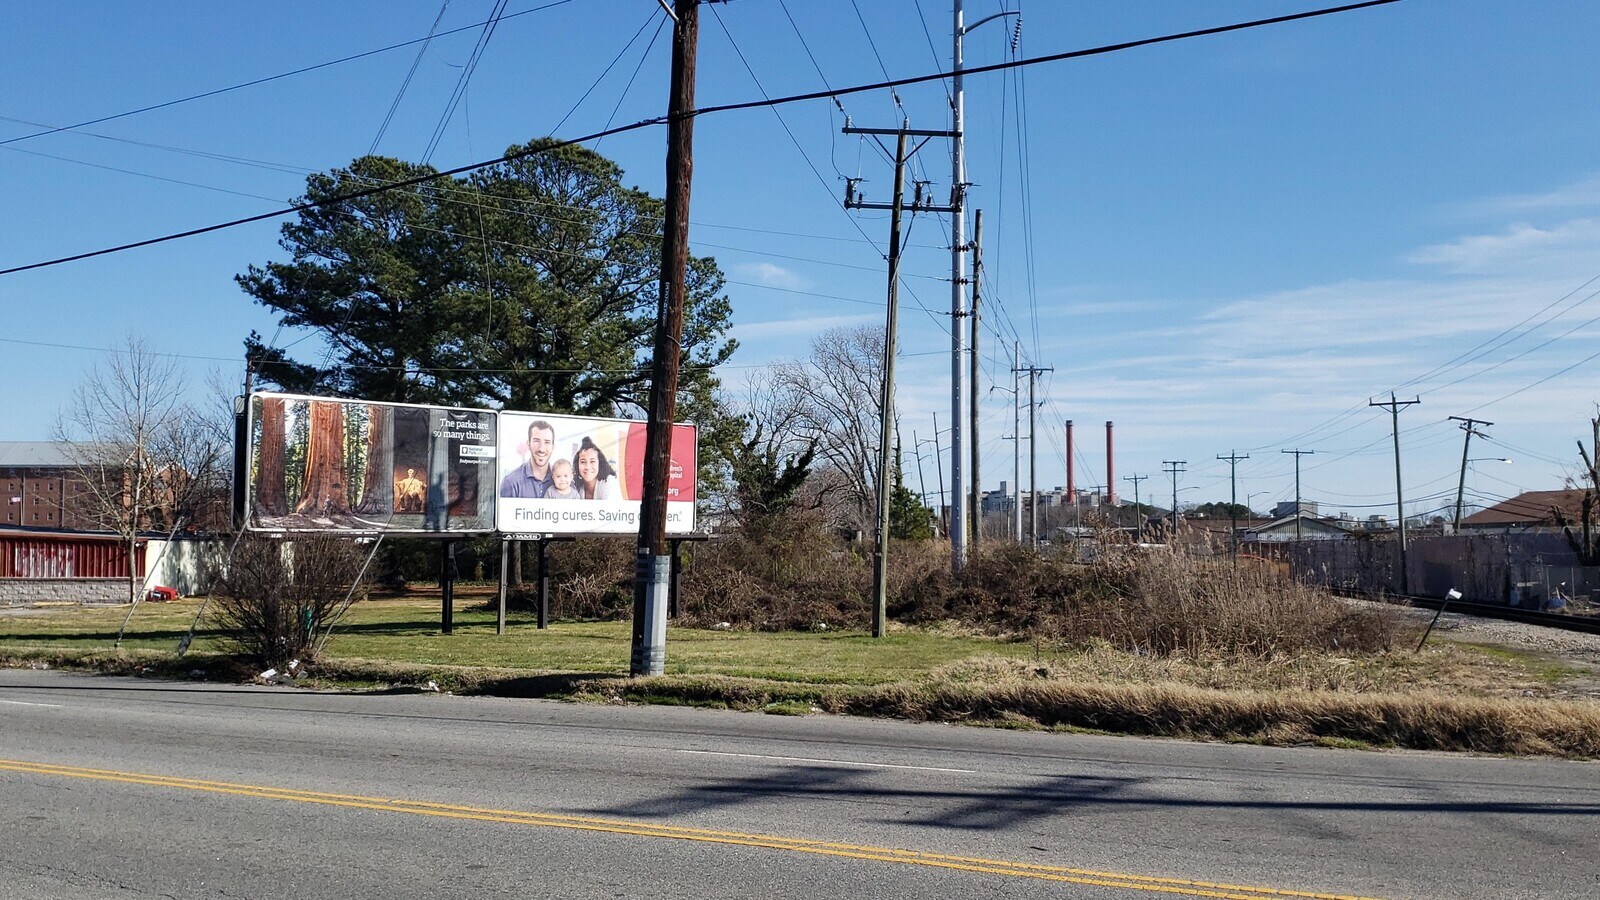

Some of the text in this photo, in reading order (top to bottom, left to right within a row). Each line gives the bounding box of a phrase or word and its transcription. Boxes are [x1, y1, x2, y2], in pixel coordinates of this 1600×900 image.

[440, 418, 455, 427] The
[456, 420, 476, 429] parks
[443, 431, 465, 440] many
[515, 508, 559, 524] Finding
[562, 509, 595, 521] cures.
[598, 510, 635, 524] Saving
